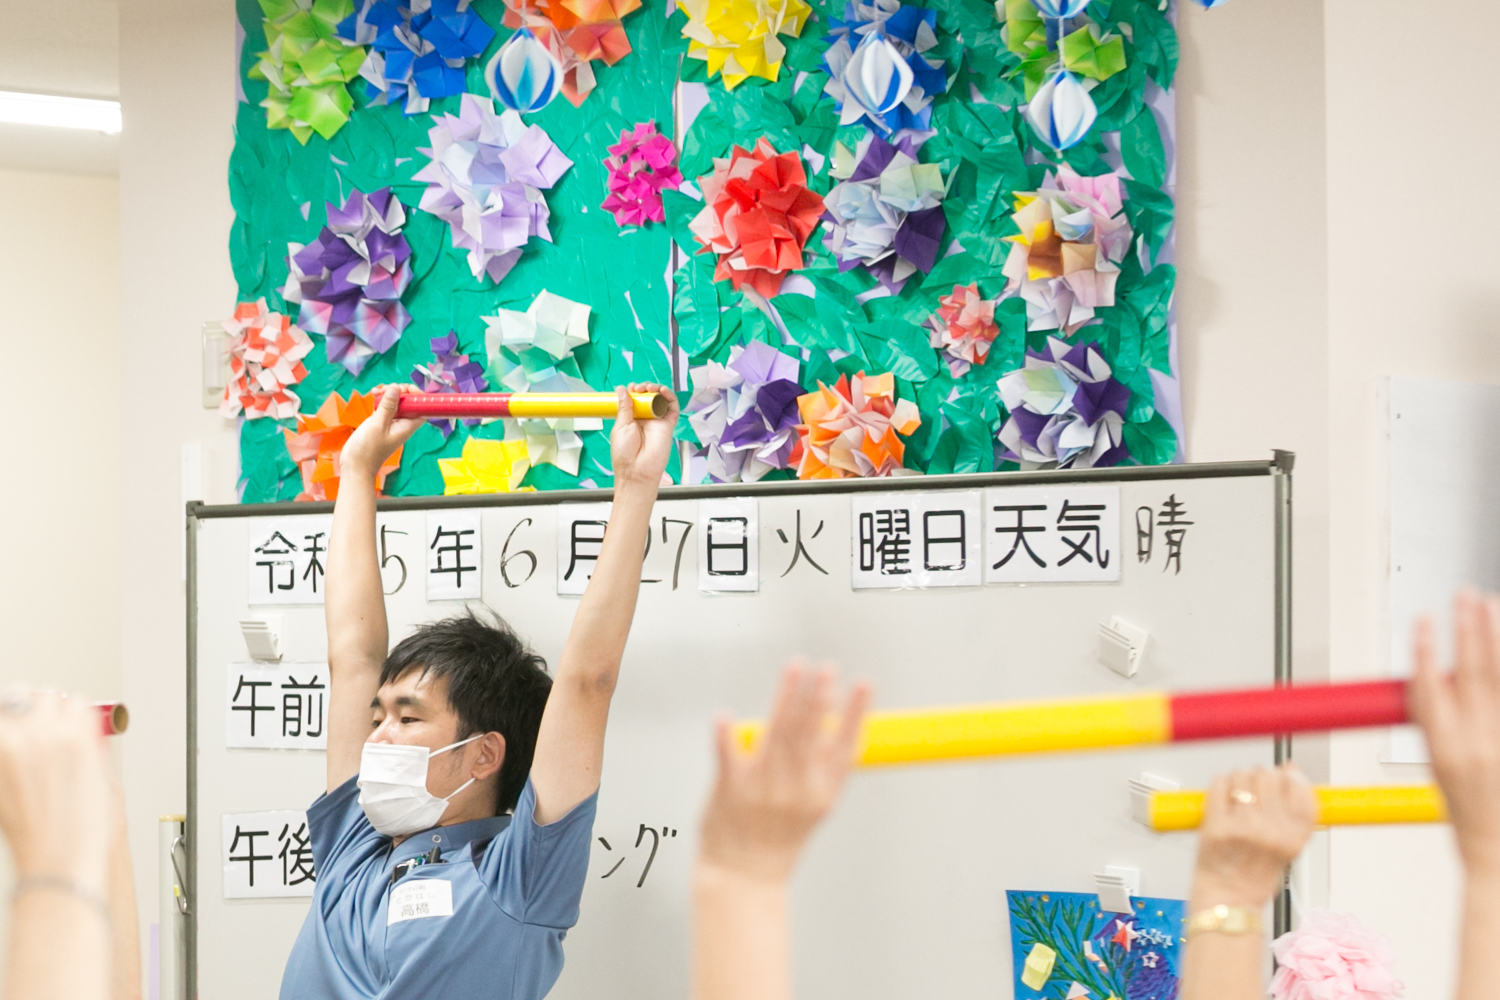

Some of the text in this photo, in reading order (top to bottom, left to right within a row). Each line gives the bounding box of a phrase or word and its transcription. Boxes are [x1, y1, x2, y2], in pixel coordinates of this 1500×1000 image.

[231, 674, 326, 738] 午前
[228, 822, 678, 889] 午後 ング
